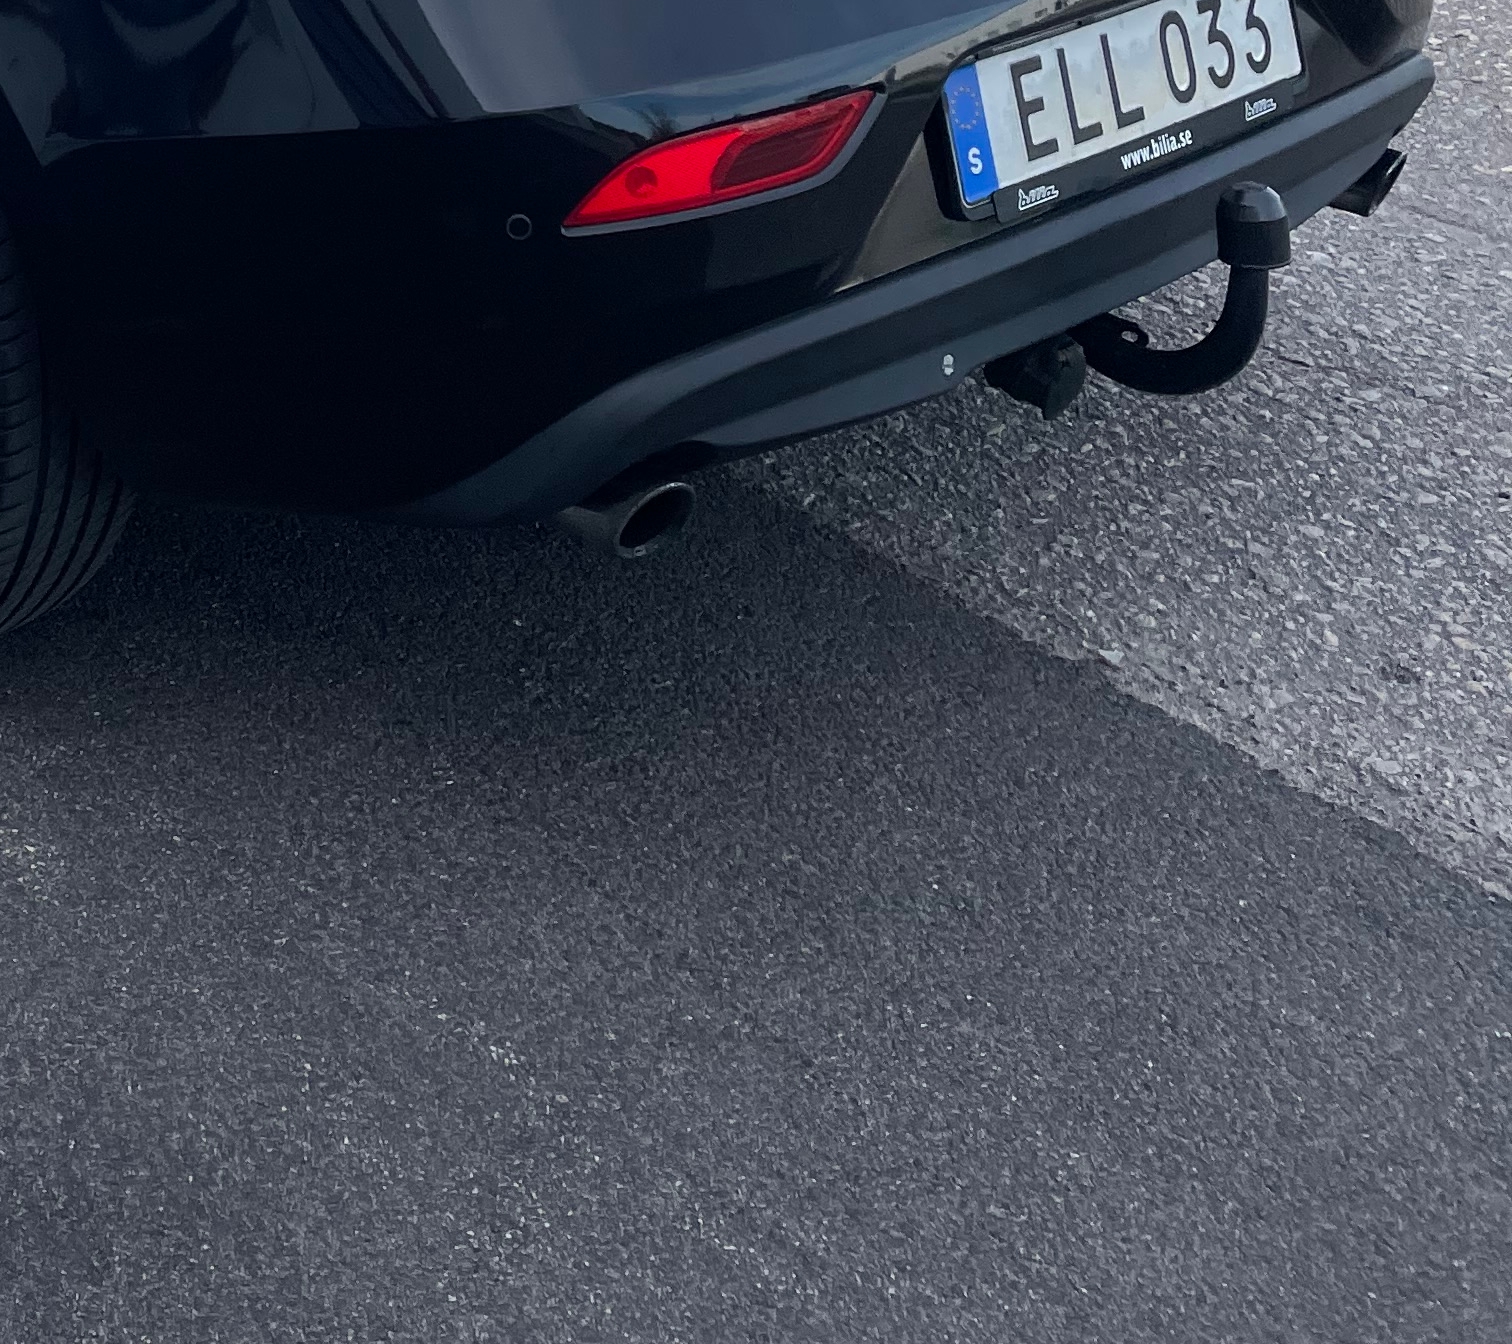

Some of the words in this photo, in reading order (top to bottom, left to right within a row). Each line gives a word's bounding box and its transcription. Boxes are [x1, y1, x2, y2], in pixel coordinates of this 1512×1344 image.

[1009, 32, 1146, 162] ELL
[967, 146, 984, 175] S
[1120, 127, 1194, 171] www.bilia.se
